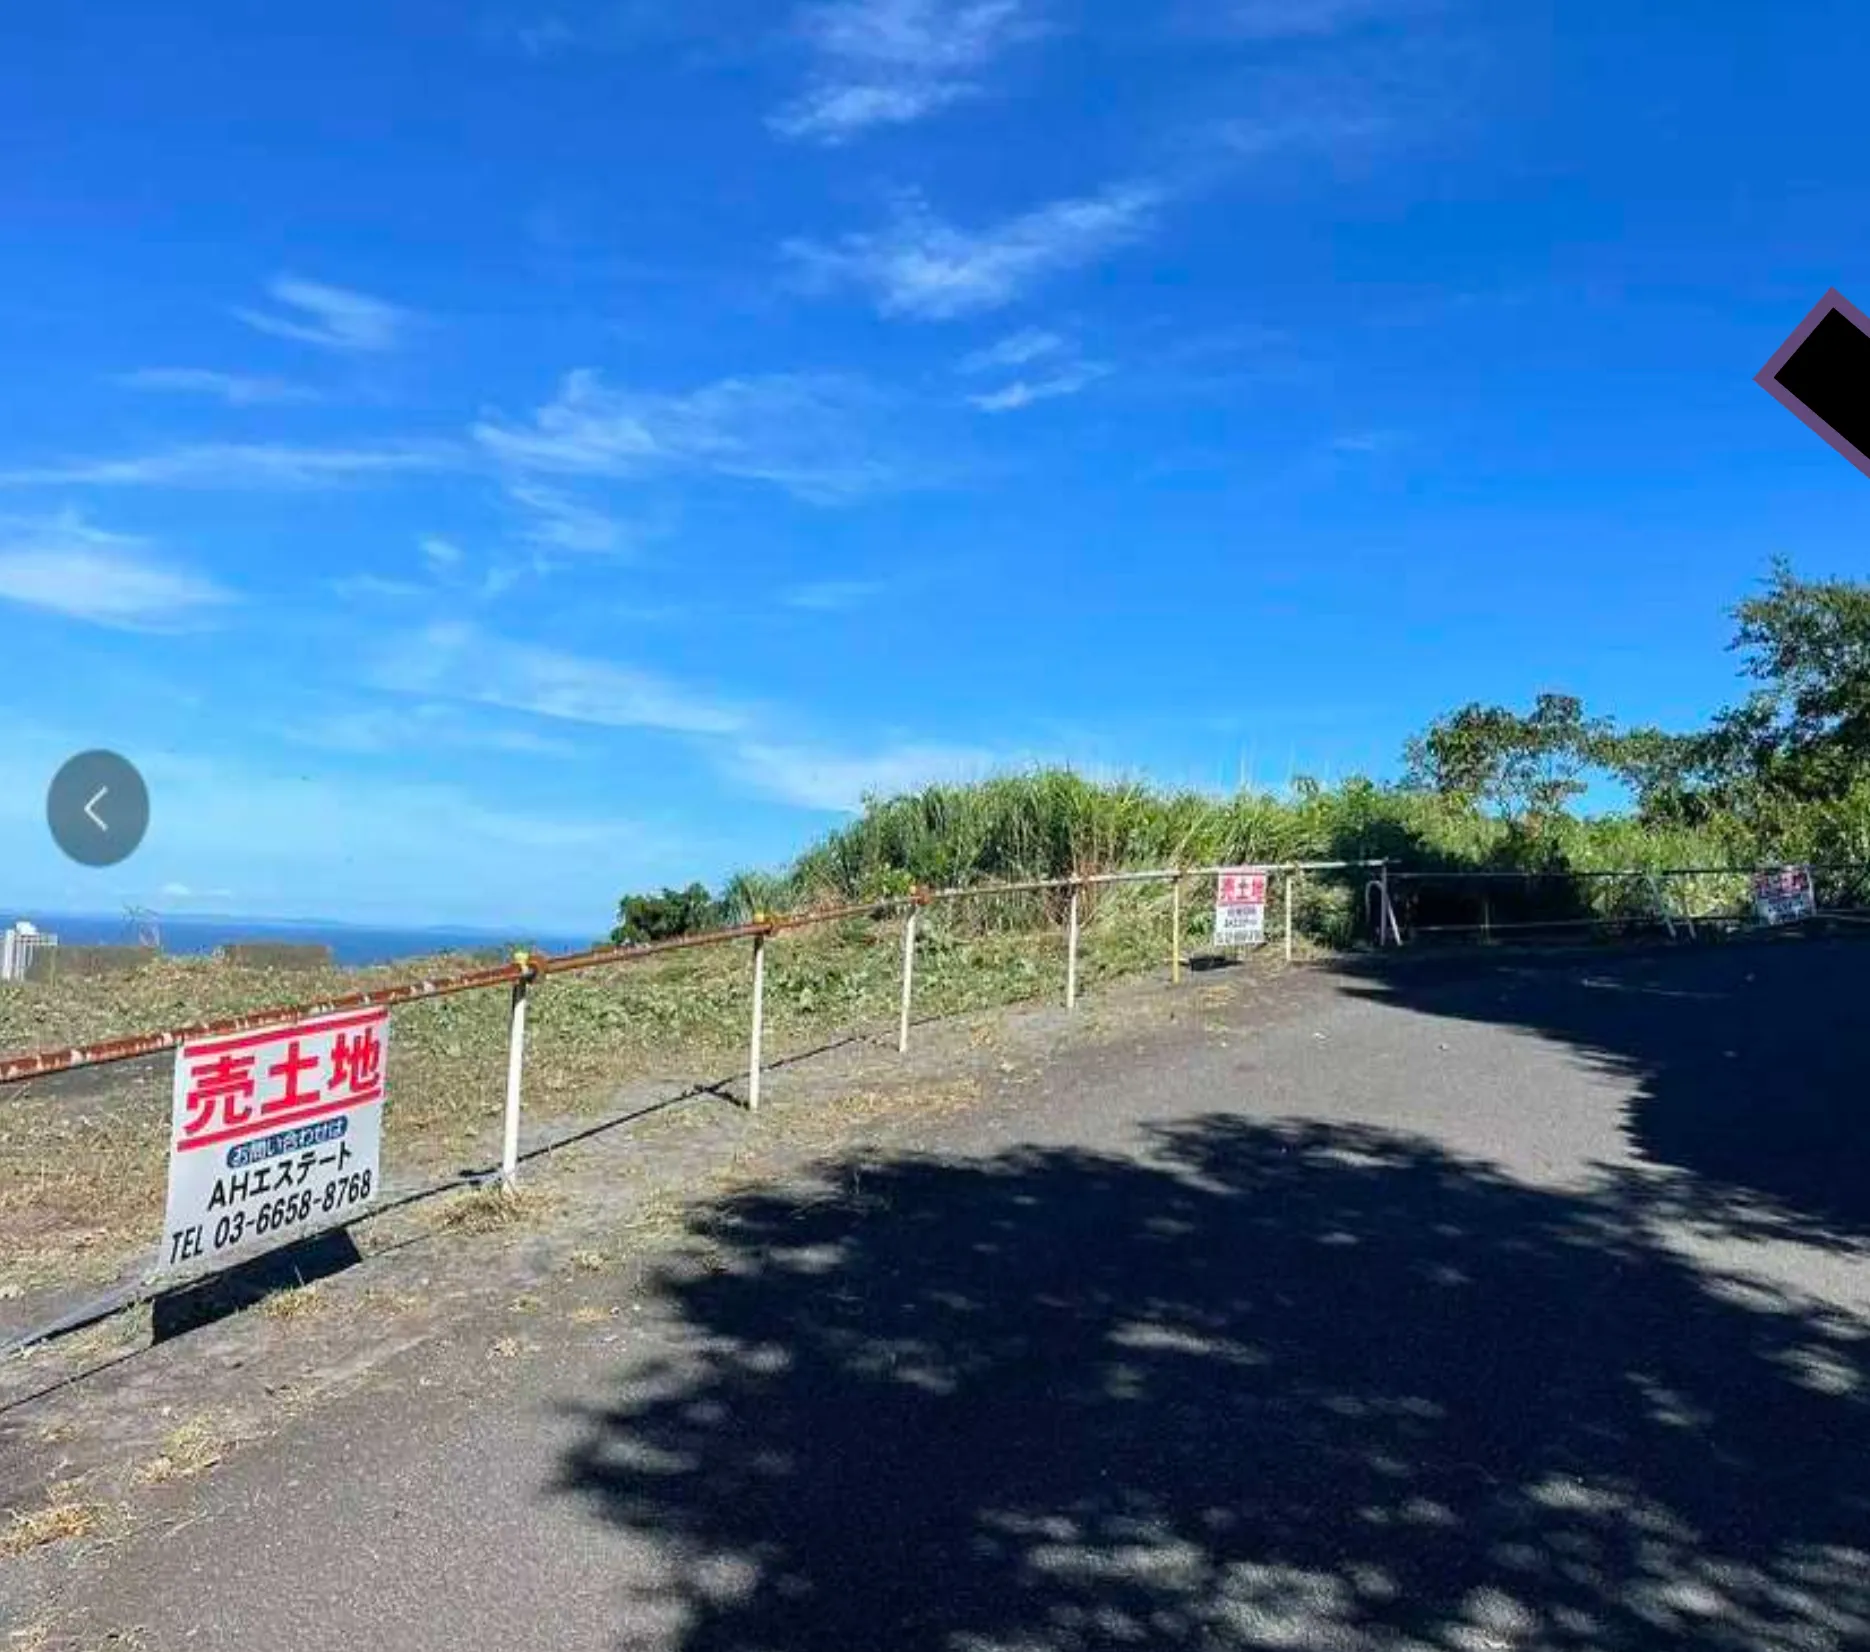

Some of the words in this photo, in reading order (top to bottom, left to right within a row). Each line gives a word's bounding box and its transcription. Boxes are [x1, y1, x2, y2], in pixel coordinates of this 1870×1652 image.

[184, 1027, 381, 1134] 売土地
[170, 1226, 203, 1264] TEL
[214, 1169, 372, 1249] 03-6658-8768
[207, 1141, 352, 1211] AHエステート
